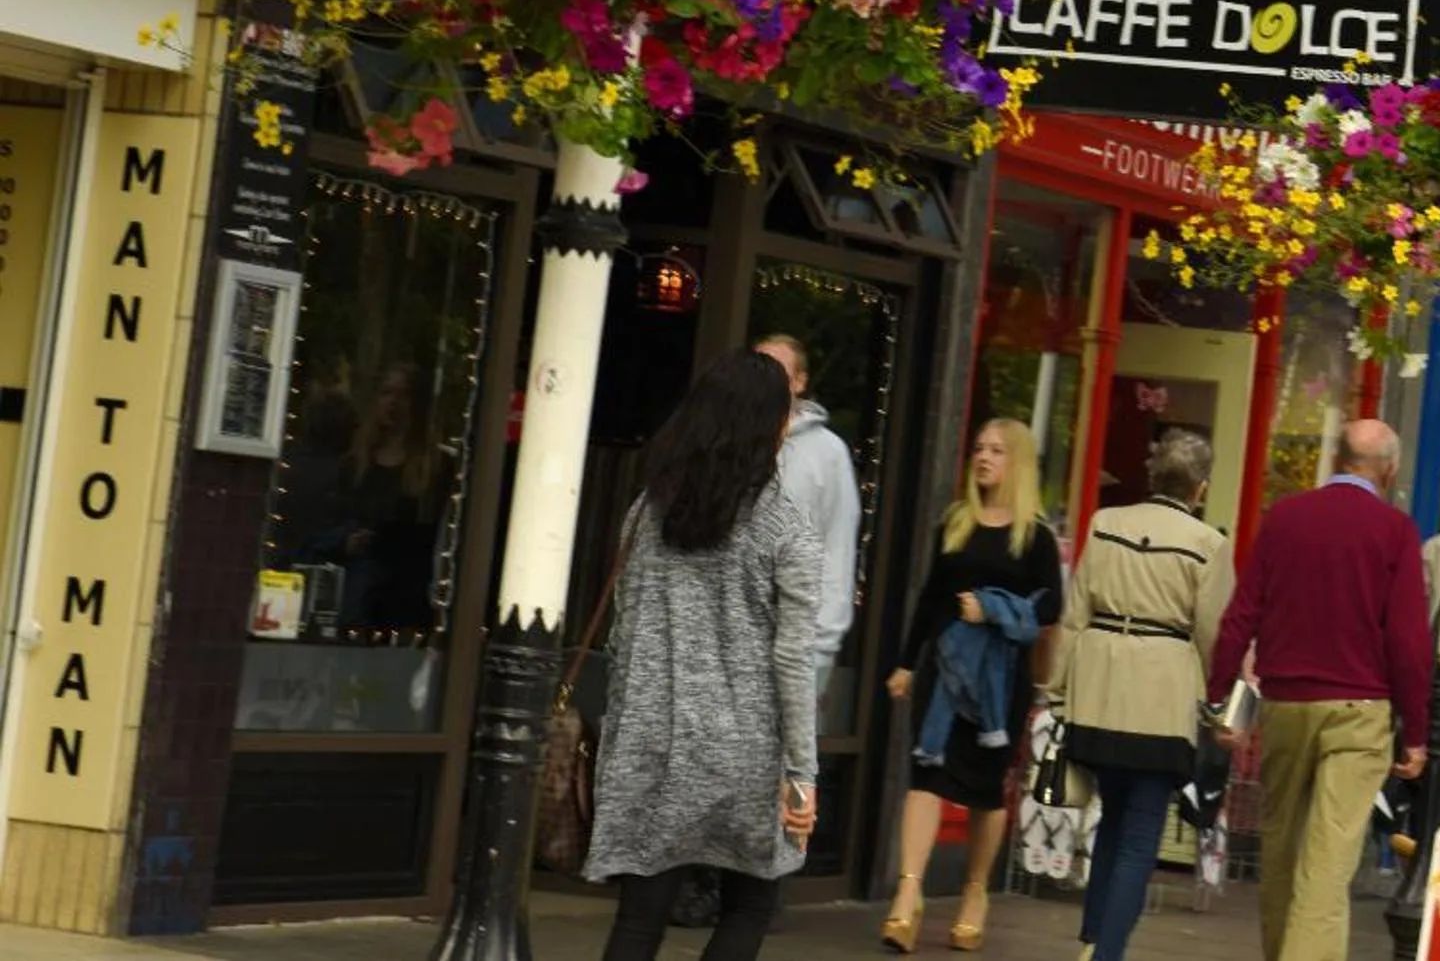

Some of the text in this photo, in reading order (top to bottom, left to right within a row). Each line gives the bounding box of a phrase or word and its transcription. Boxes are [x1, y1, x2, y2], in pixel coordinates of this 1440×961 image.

[1213, 0, 1399, 63] DOLCE
[45, 146, 165, 777] MAN TO MAN
